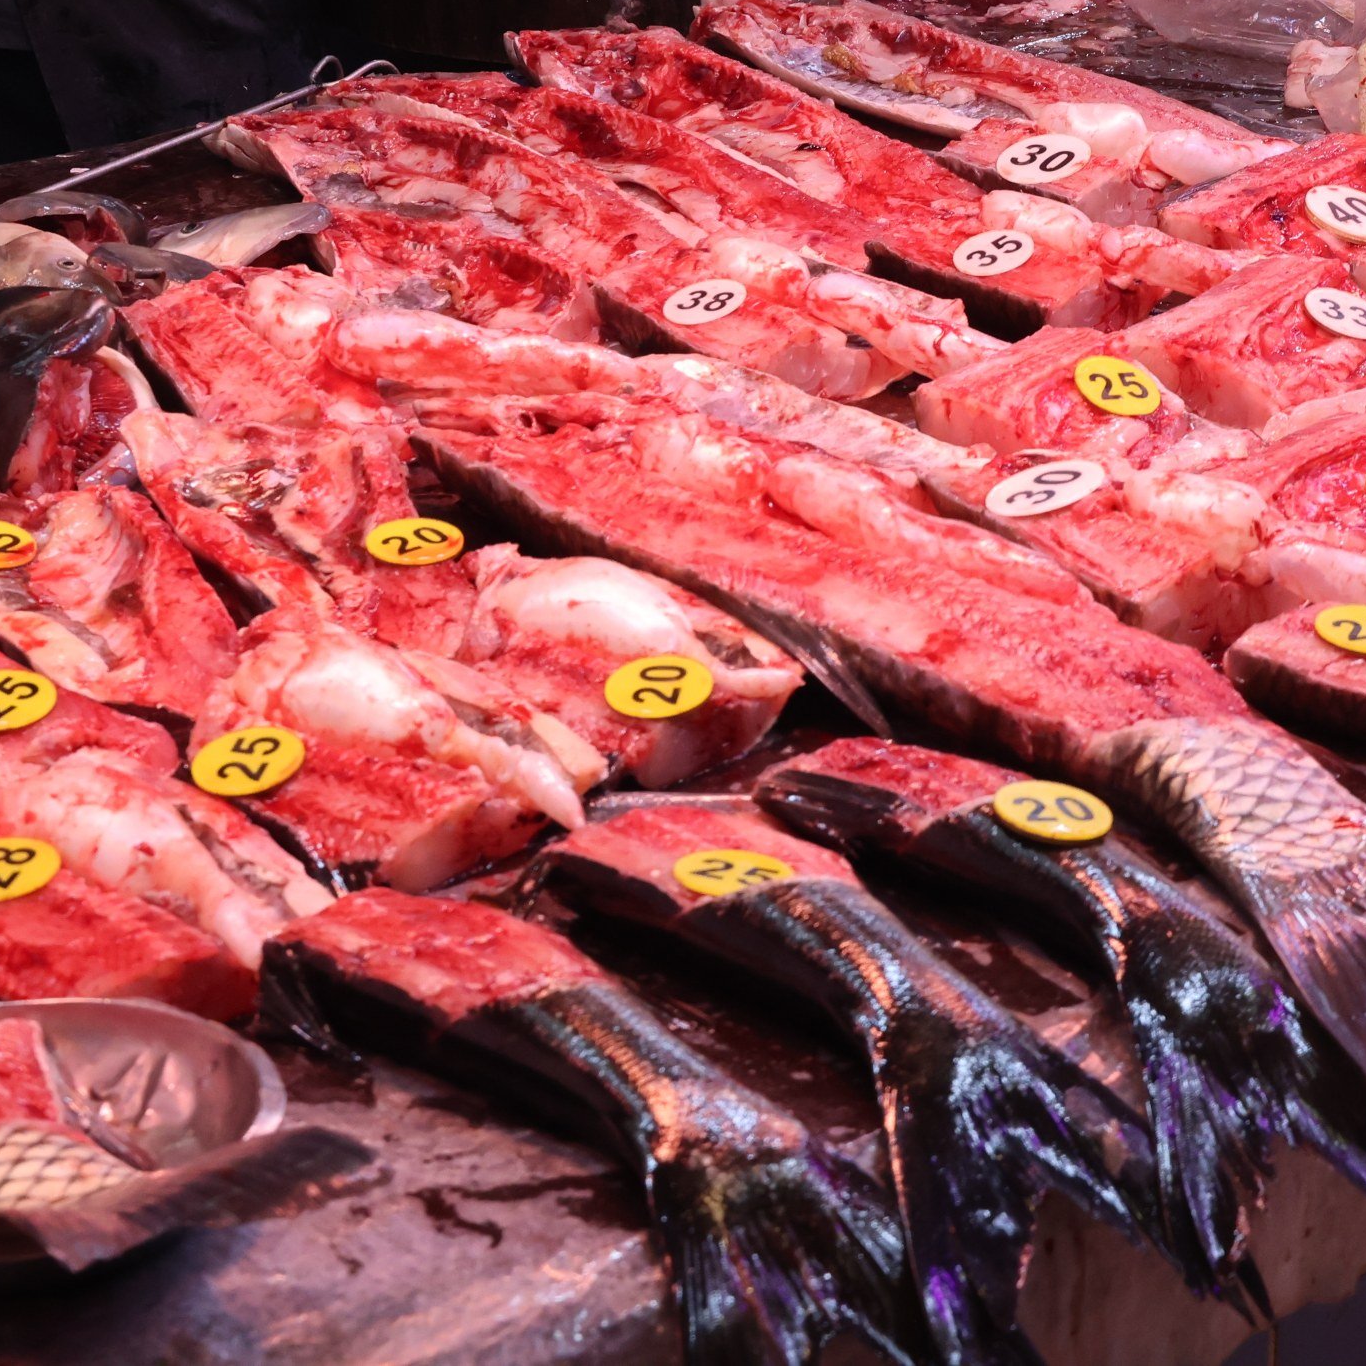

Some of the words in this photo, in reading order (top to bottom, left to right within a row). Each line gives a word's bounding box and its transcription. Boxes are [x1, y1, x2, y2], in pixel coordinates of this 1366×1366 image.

[1010, 144, 1075, 172] 30
[966, 235, 1023, 267] 35
[677, 290, 735, 312] 38
[1089, 372, 1149, 400] 25
[1007, 470, 1081, 507] 30
[382, 528, 449, 556] 20
[632, 665, 687, 705] 20
[217, 737, 281, 782] 25
[1011, 796, 1093, 822] 20
[695, 858, 780, 887] 25
